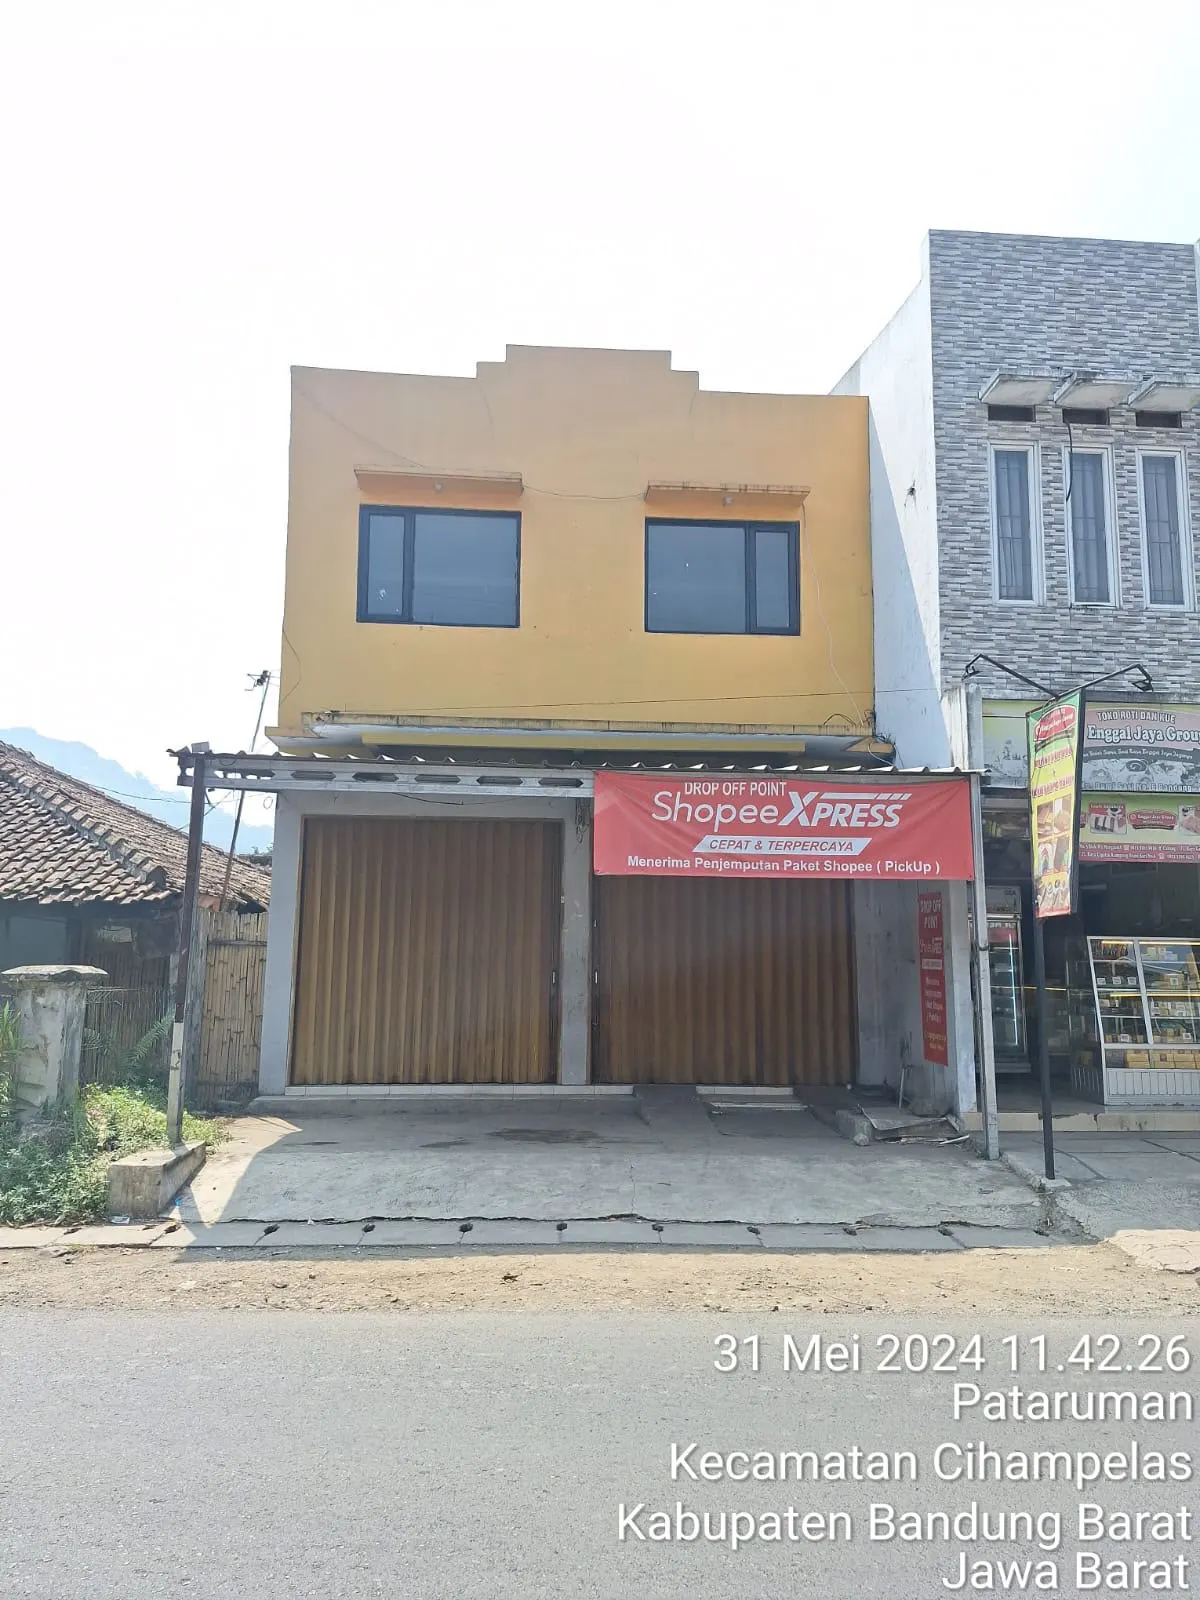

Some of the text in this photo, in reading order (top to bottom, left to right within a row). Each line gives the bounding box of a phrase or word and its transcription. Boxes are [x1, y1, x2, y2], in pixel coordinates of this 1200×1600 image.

[1097, 710, 1176, 724] TOKO ROTI DAN KUE
[1087, 724, 1200, 744] Enggal Jaya Grou
[684, 782, 787, 796] DROP OFF POINT
[651, 790, 903, 833] Shopee XPRESS
[709, 839, 853, 851] CEPAT & TERPERCAYA
[627, 855, 691, 868] Menerima
[694, 857, 780, 872] Penjemputan
[783, 859, 820, 872] Paket
[823, 860, 873, 873] Shopee
[885, 860, 932, 874] PickUp
